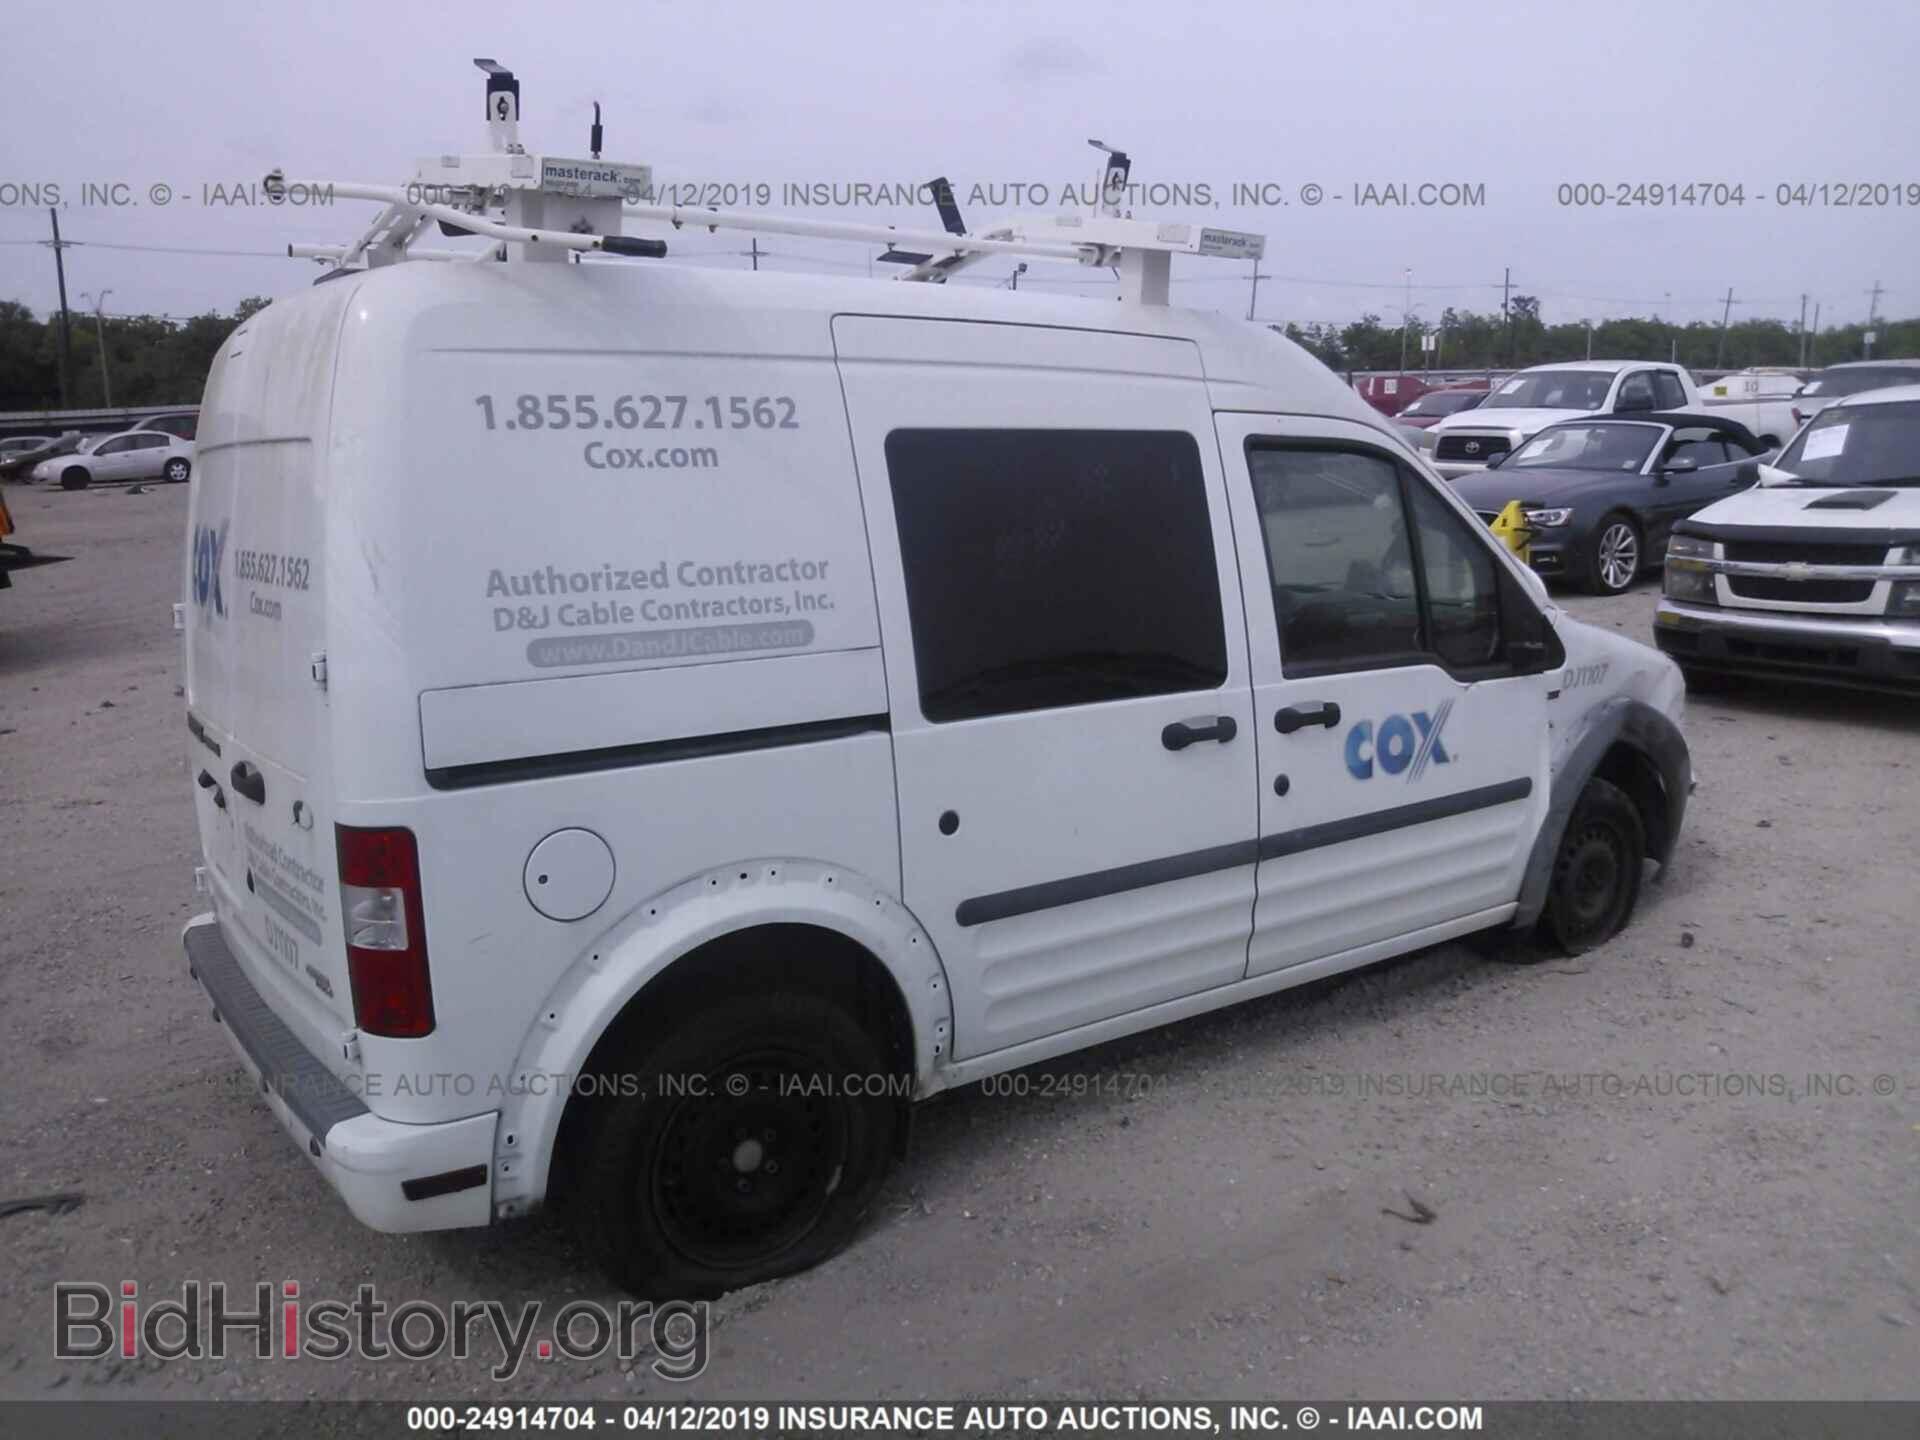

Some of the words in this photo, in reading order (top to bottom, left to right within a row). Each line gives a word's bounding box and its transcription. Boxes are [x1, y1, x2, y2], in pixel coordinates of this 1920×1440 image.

[475, 394, 800, 430] 1.855.627.1562
[583, 441, 719, 469] Cox.com
[486, 562, 668, 598] Authorized
[677, 558, 830, 588] Contractor
[494, 606, 550, 632] D&J
[558, 601, 634, 627] Cable
[641, 594, 790, 622] Contractors,
[795, 590, 835, 611] Inc.
[1344, 698, 1455, 785] COX
